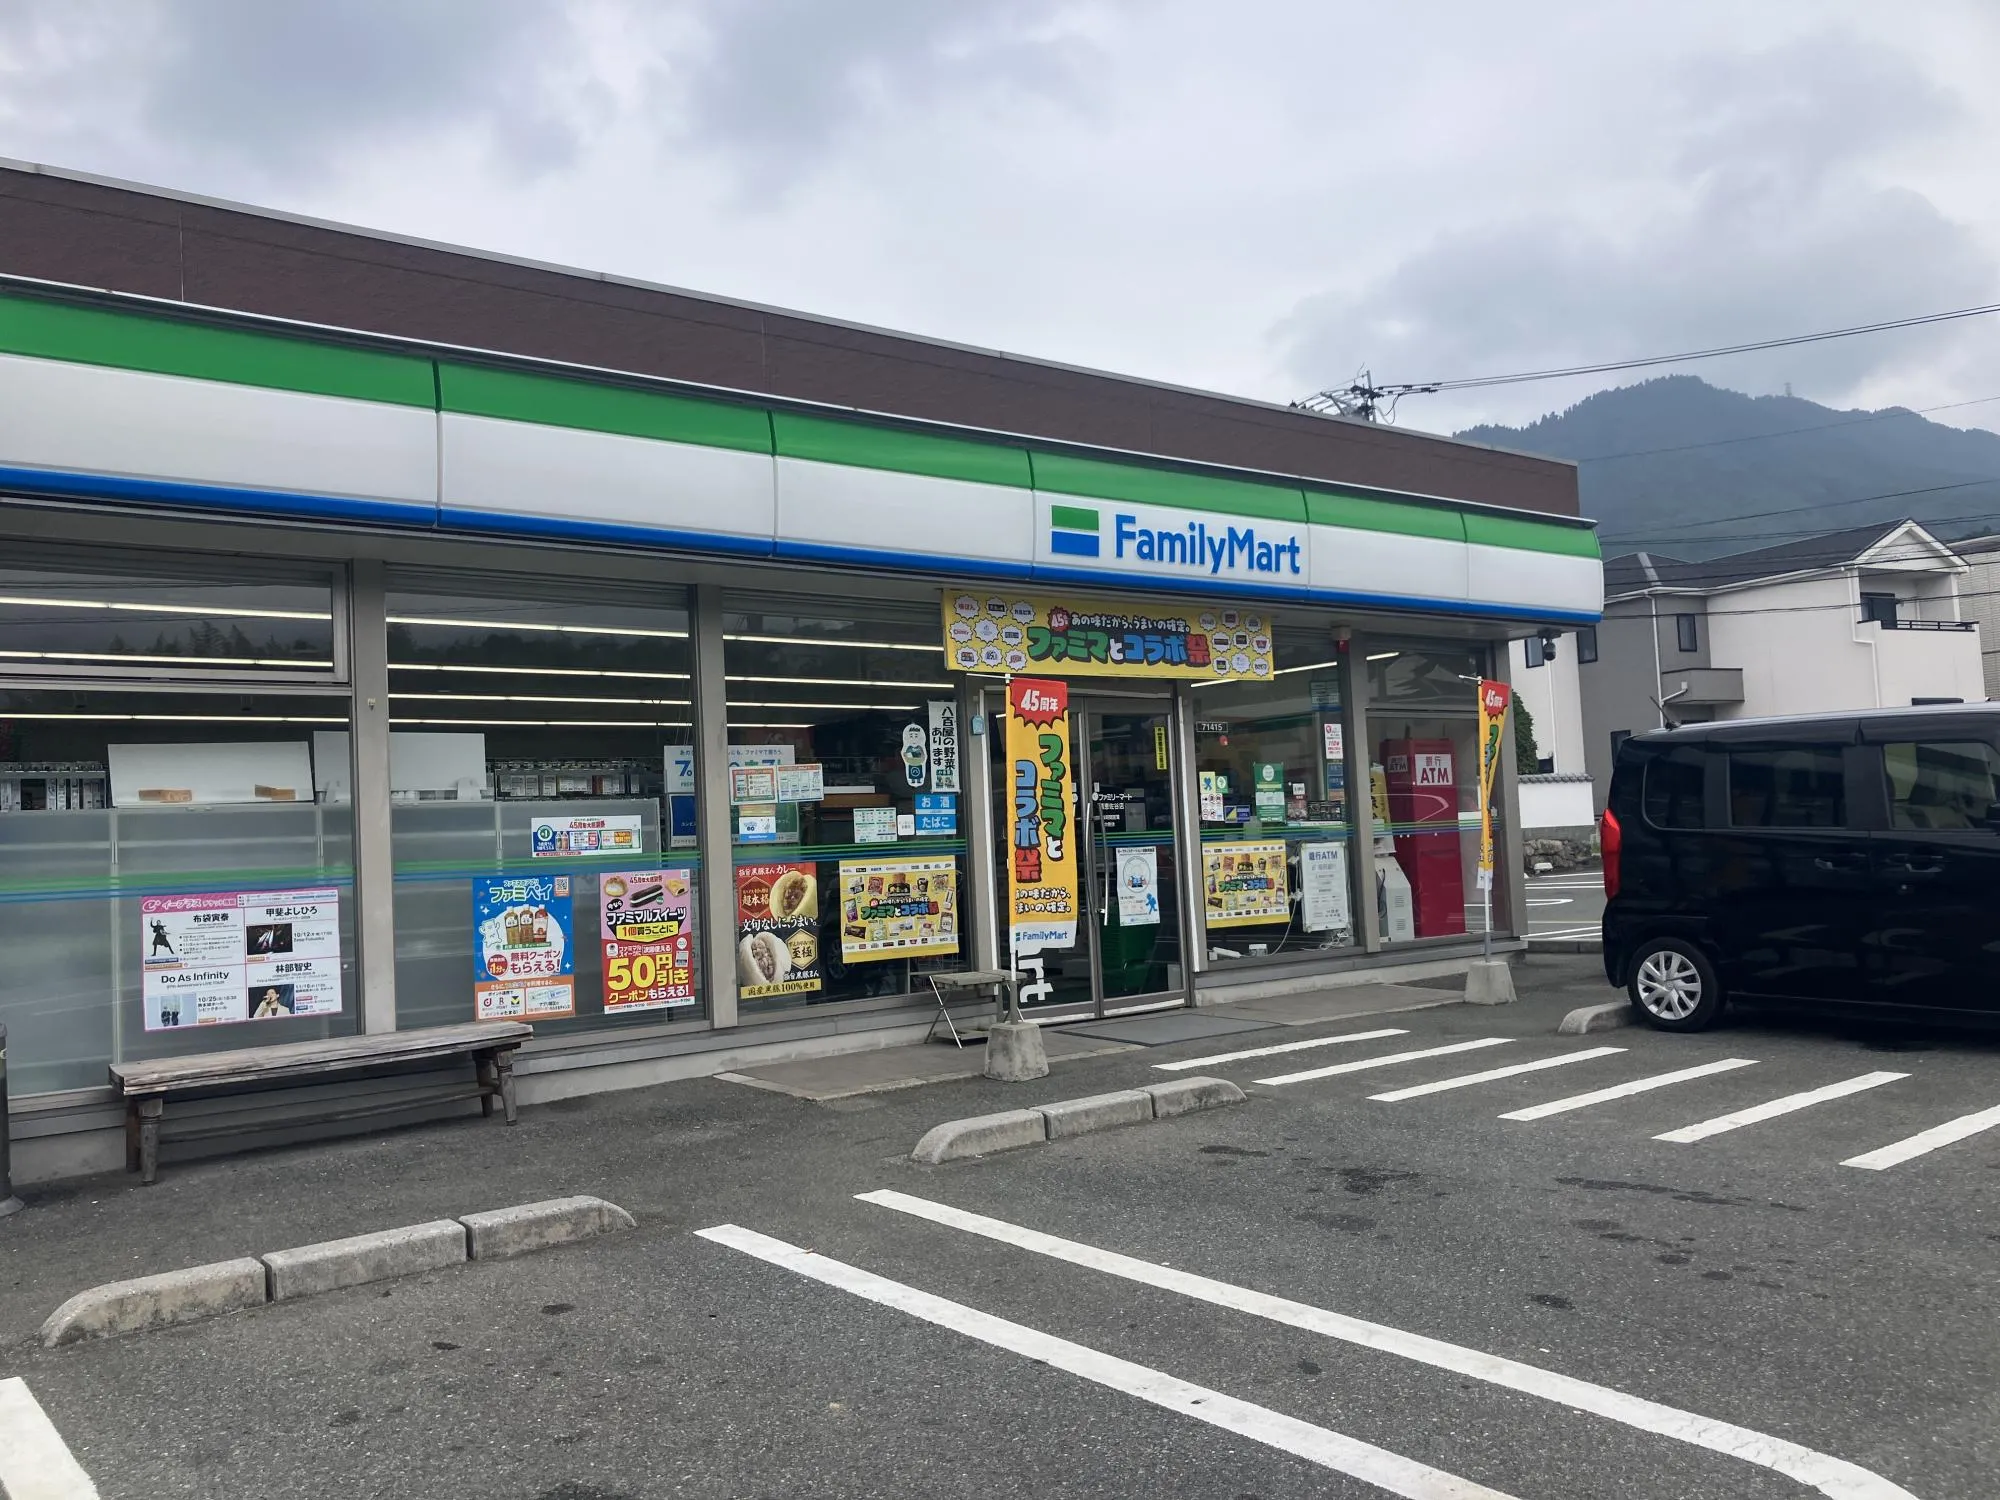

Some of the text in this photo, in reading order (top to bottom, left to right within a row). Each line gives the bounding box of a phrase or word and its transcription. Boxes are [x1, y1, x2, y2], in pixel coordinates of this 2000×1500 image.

[1115, 514, 1300, 574] FamilyMart
[1071, 612, 1190, 633] あの味だから、うまいの確定。
[1021, 689, 1058, 712] 45周年
[1201, 723, 1223, 731] 71415
[942, 706, 956, 770] 八百屋の野菜
[931, 726, 943, 767] あります
[1420, 767, 1450, 784] ATM
[921, 796, 950, 808] お酒
[1039, 733, 1066, 861] ファミマと
[1098, 793, 1132, 801] ファミリーマート
[921, 816, 951, 829] たばこ
[776, 864, 796, 875] カレー
[489, 884, 553, 903] ファミペイ
[743, 894, 769, 906] 超本格
[193, 913, 229, 923] 布袋寅泰
[266, 906, 318, 917] 甲斐よしひろ
[606, 906, 687, 926] ファミマルスイーツ
[622, 924, 674, 937] 1個買うごとに
[742, 915, 817, 933] 文句なしに、うまい。
[1022, 931, 1068, 941] FamilyMart
[510, 950, 561, 962] 無料クーポン
[792, 945, 812, 959] 至極
[275, 962, 312, 973] 林部智史
[510, 958, 561, 974] もらえる!
[161, 971, 230, 983] Do As Infinity
[608, 984, 689, 1004] クーポンもらえる!
[748, 981, 816, 996] 国産黒豚100%使用
